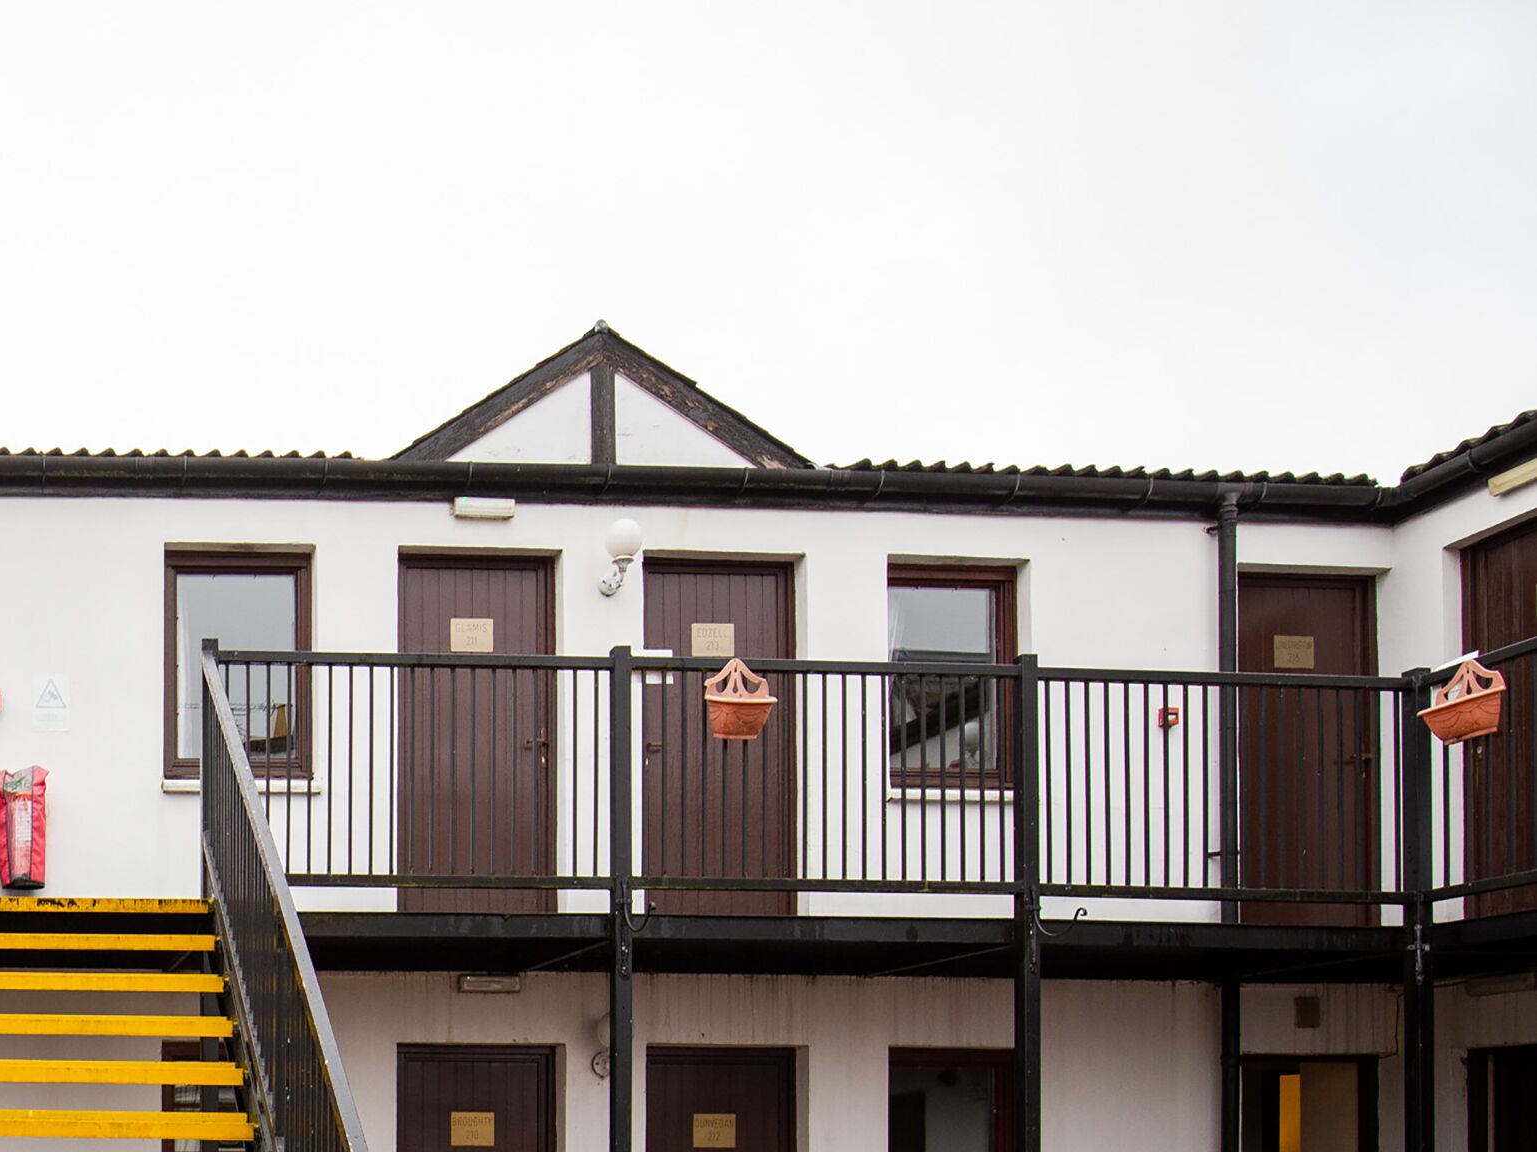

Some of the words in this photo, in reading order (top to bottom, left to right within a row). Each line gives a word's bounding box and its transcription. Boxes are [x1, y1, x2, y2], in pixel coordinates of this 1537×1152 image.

[455, 622, 488, 633] GLAMIS
[696, 627, 728, 638] EDZELL
[452, 1116, 492, 1127] BROUGHTY
[695, 1118, 734, 1129] DUNVEGAN
